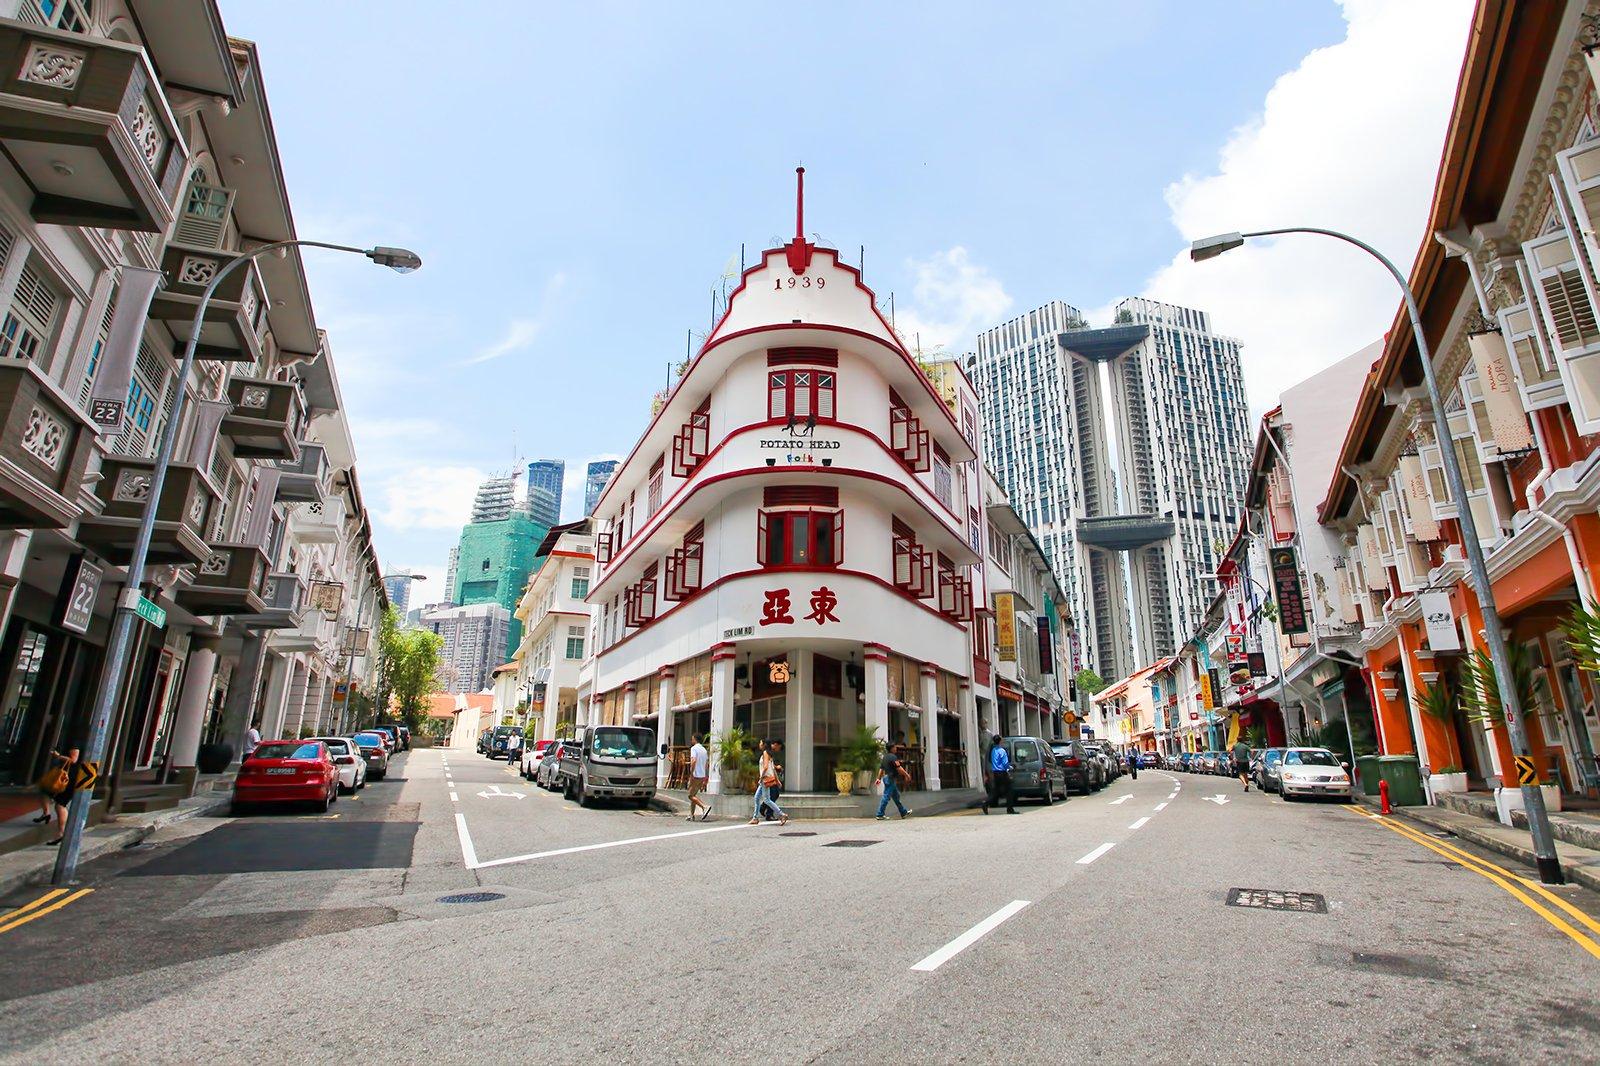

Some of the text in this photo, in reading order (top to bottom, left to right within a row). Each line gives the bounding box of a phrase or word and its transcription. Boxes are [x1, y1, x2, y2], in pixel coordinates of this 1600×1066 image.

[774, 276, 826, 290] 1939
[94, 407, 117, 420] 22
[760, 440, 841, 449] POTATO HEAD
[73, 582, 94, 614] 22
